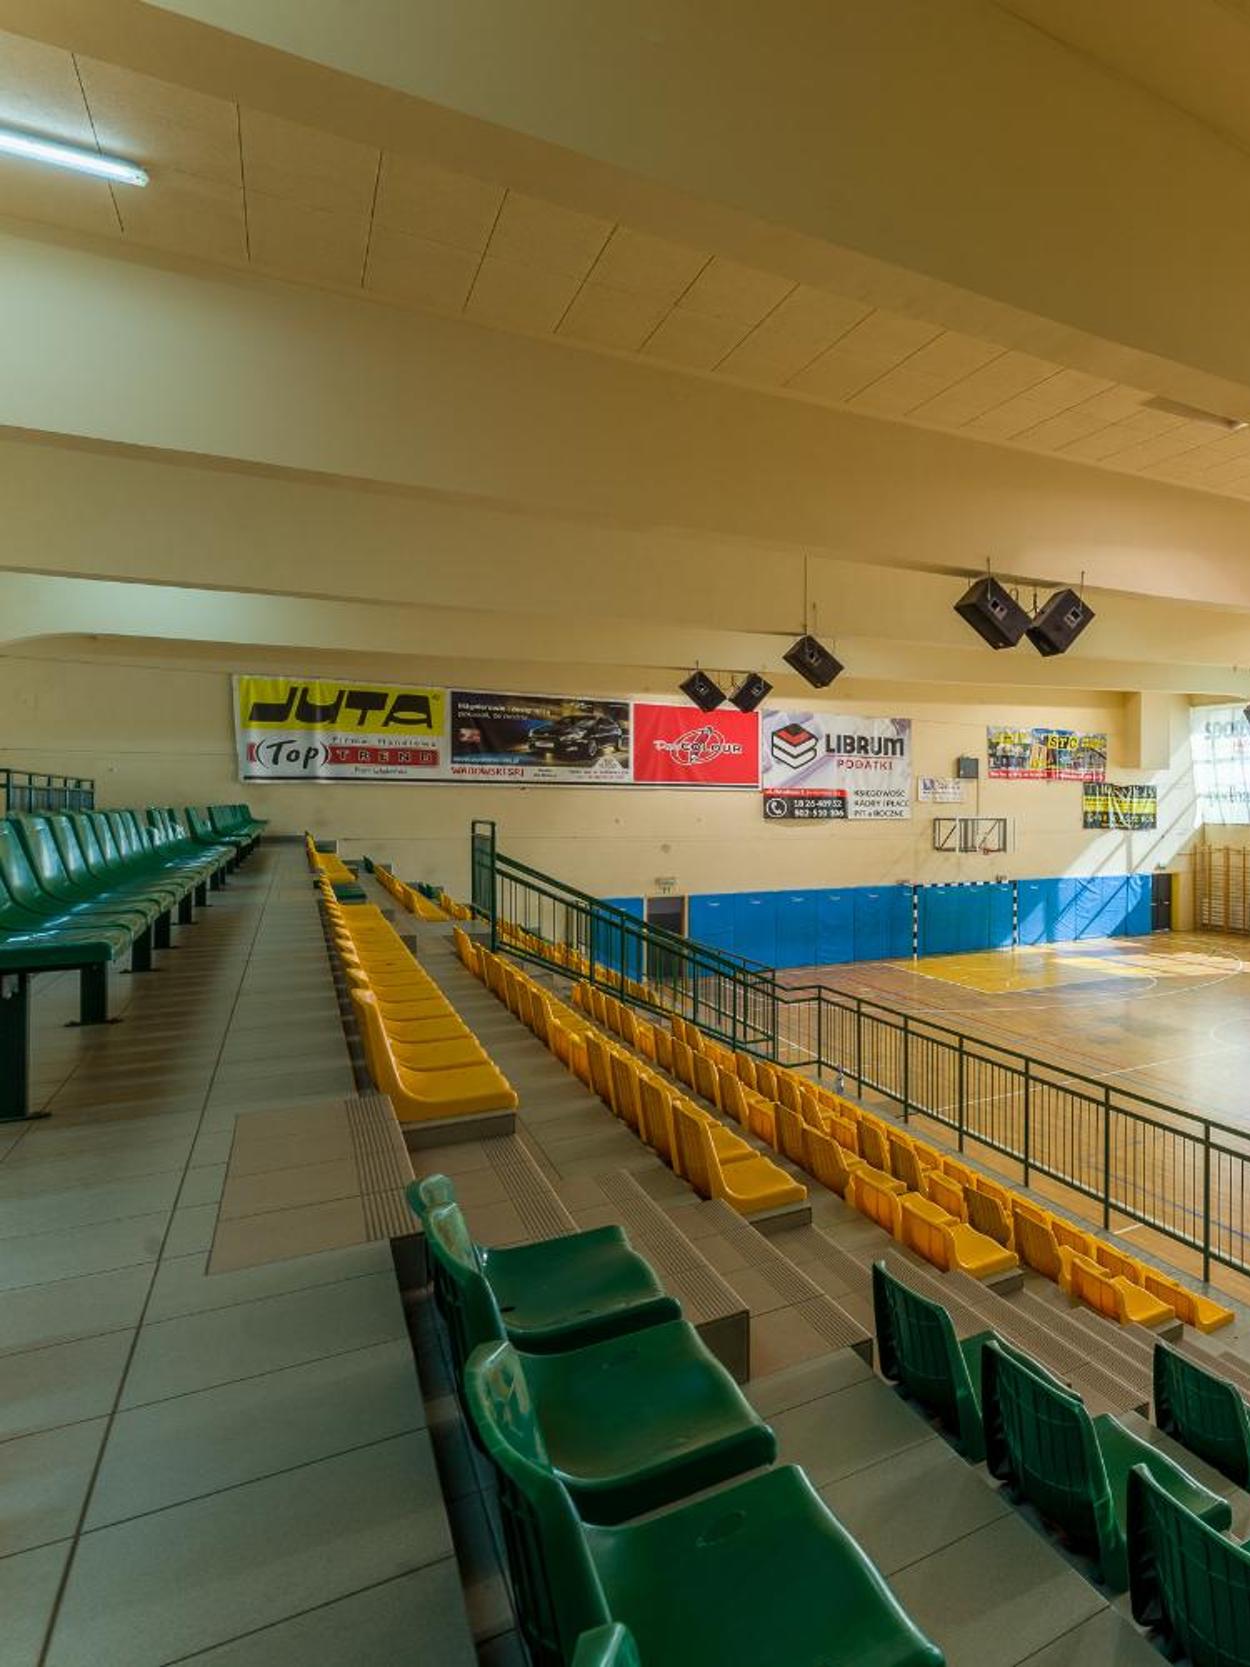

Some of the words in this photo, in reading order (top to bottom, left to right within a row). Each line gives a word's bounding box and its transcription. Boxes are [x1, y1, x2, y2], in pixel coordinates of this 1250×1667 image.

[249, 687, 432, 729] JUTA
[337, 748, 433, 763] TREND
[837, 759, 894, 771] PODATKI
